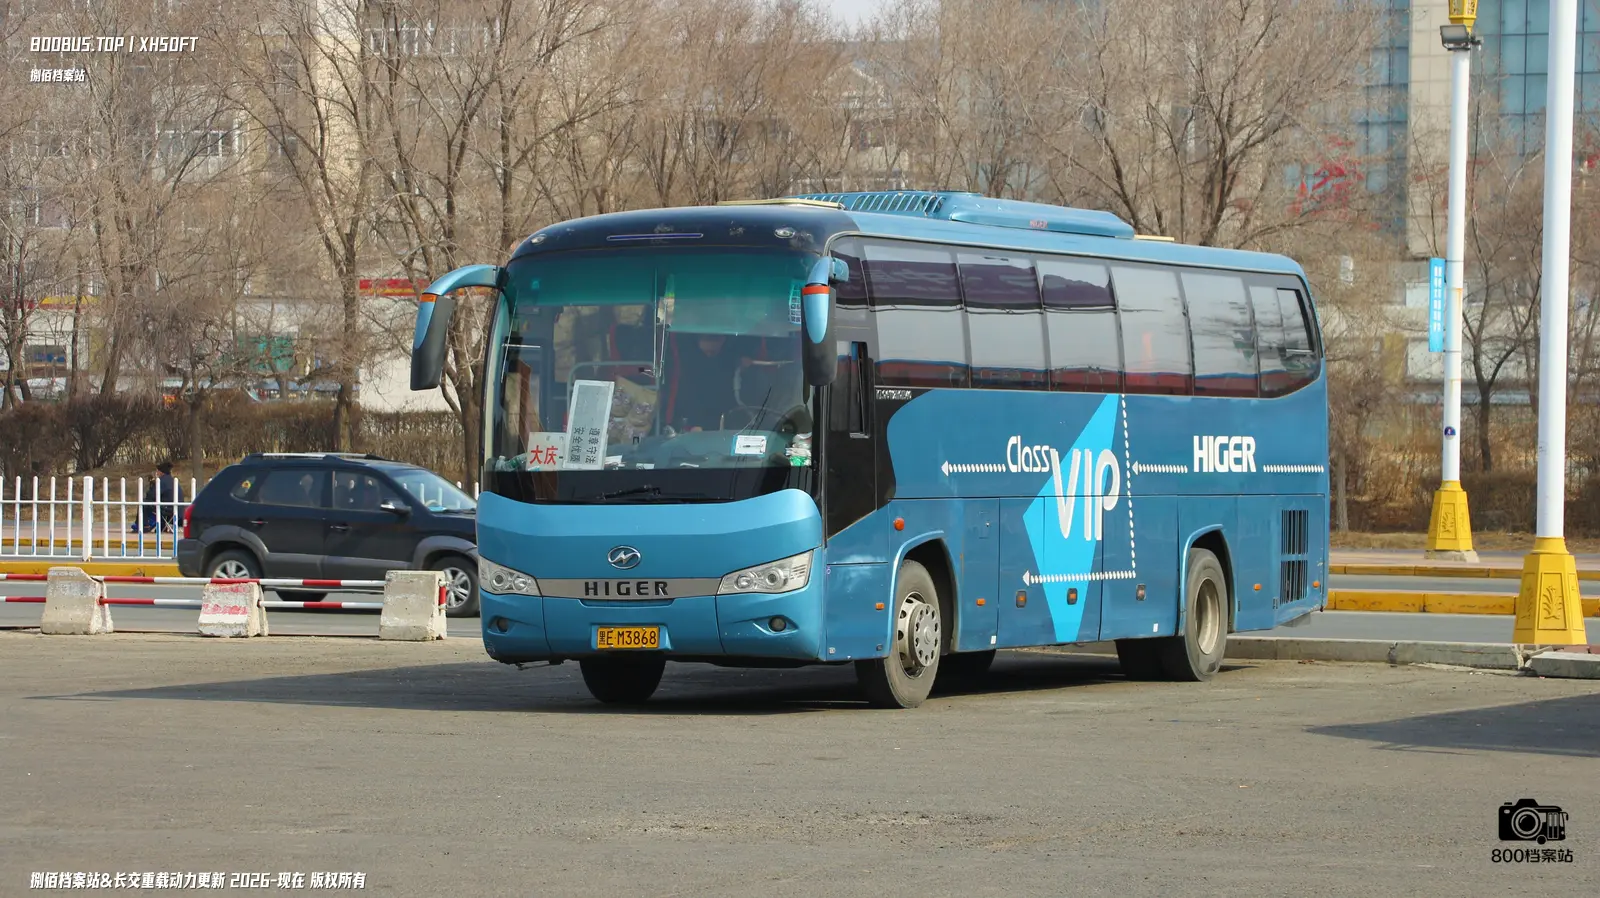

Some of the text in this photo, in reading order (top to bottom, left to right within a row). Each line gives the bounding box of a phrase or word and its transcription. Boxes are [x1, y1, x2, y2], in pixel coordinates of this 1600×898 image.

[585, 427, 601, 464] 遵章守法
[1193, 435, 1257, 473] HIGER
[1006, 435, 1121, 541] Class VIP
[584, 581, 669, 596] HIGER
